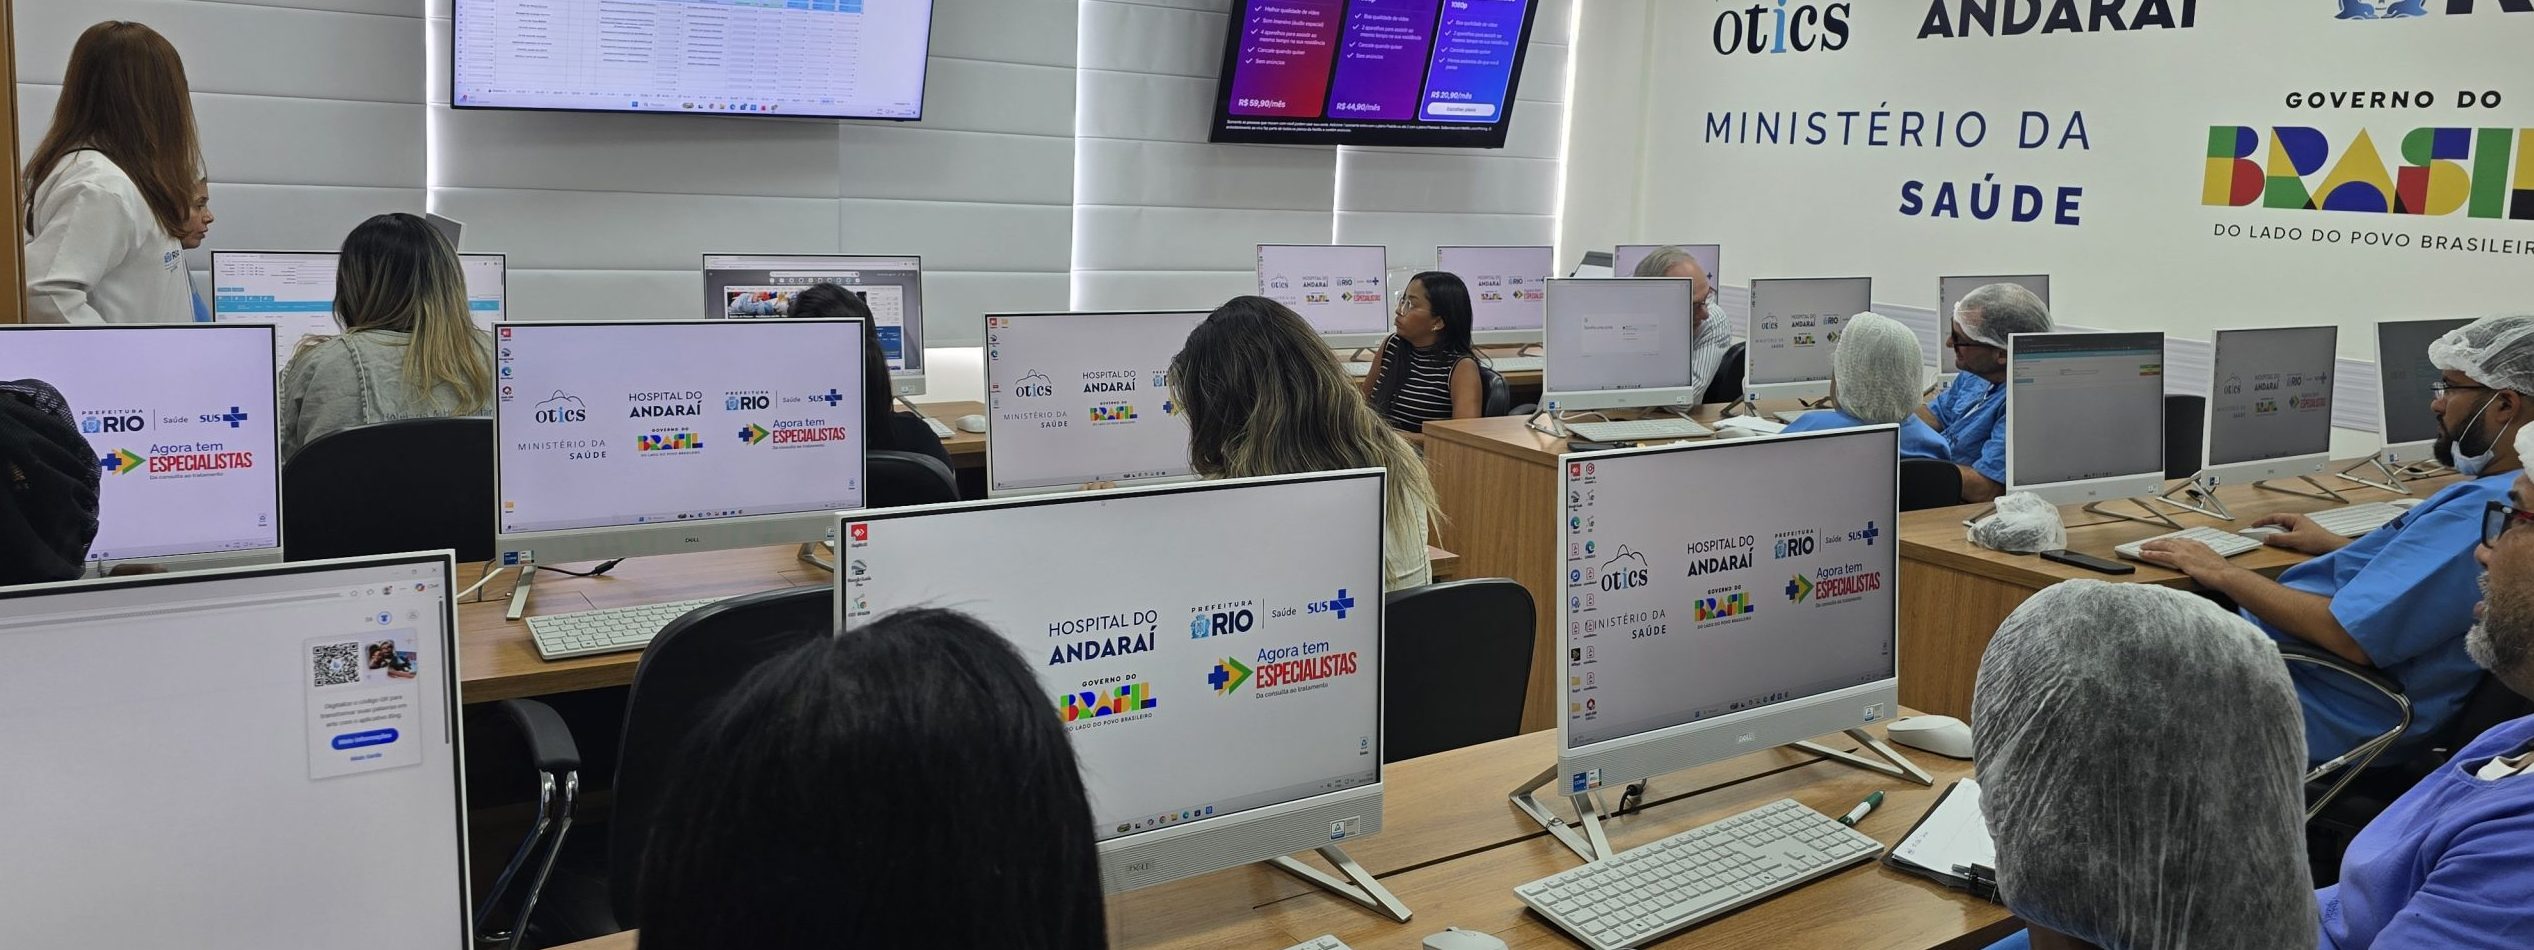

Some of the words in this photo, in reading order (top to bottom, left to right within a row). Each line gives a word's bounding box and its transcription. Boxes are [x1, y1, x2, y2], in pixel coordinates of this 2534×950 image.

[1713, 0, 1850, 55] otics
[1431, 91, 1440, 99] R$
[2285, 91, 2435, 109] GOVERNO
[2456, 90, 2502, 109] DO
[1238, 98, 1249, 107] R$
[1249, 98, 1286, 109] 59,90/mês
[1336, 102, 1346, 111] R$
[1705, 101, 1987, 148] MINISTÉRIO
[2018, 110, 2090, 150] DA
[1899, 172, 2083, 226] SAÚDE
[2214, 223, 2241, 237] DO
[2249, 225, 2302, 241] LADO
[2312, 229, 2341, 243] DO
[2350, 231, 2410, 247] POVO
[1082, 370, 1122, 380] HOSPITAL
[1123, 369, 1136, 378] DO
[1015, 383, 1052, 398] otics
[1083, 378, 1136, 394] ANDARAÍ
[628, 392, 682, 402] HOSPITAL
[686, 390, 703, 400] DO
[740, 396, 770, 410] RIO
[808, 395, 824, 403] SUS
[535, 406, 586, 424] otics
[629, 400, 702, 418] ANDARAÍ
[1003, 409, 1053, 421] MINISTÉRIO
[1055, 410, 1068, 418] DA
[1089, 405, 1138, 422] BRASIL
[103, 415, 145, 433] RIO
[163, 416, 189, 424] Saúde
[199, 414, 221, 423] SUS
[773, 419, 803, 429] Agora
[806, 418, 825, 427] tem
[1040, 419, 1068, 429] SAÚDE
[637, 432, 703, 451] BRASIL
[772, 427, 846, 443] ESPECIALISTAS
[150, 443, 192, 456] Agora
[196, 442, 223, 452] tem
[518, 439, 586, 451] MINISTÉRIO
[591, 439, 606, 447] DA
[149, 452, 253, 473] ESPECIALISTAS
[569, 450, 607, 460] SAÚDE
[1774, 529, 1814, 538] PREFEITURA
[1825, 535, 1842, 544] Saúde
[1848, 530, 1862, 541] SUS
[1687, 537, 1736, 555] HOSPITAL
[1739, 535, 1755, 547] DO
[1787, 536, 1814, 557] RIO
[1687, 547, 1754, 577] ANDARAÍ
[1816, 566, 1843, 580] Agora
[1845, 562, 1862, 573] tem
[1601, 567, 1648, 592] otics
[1815, 571, 1880, 600] ESPECIALISTAS
[1707, 585, 1732, 595] GOVERNO
[1191, 600, 1253, 613] PREFEITURA
[1271, 607, 1297, 618] Saúde
[1307, 601, 1328, 614] SUS
[1652, 608, 1666, 619] DA
[1694, 591, 1754, 624] BRASIL
[1049, 613, 1129, 638] HOSPITAL
[1133, 609, 1158, 626] DO
[1211, 609, 1254, 637] RIO
[1632, 624, 1667, 640] SAÚDE
[1049, 624, 1158, 666] ANDARAÍ
[1257, 646, 1299, 664] Agora
[1303, 641, 1329, 655] tem
[1256, 651, 1358, 689] ESPECIALISTAS
[1082, 675, 1121, 687] GOVERNO
[1125, 673, 1137, 681] DO
[1265, 688, 1290, 698] consulta
[1298, 683, 1329, 693] tratamento
[1058, 682, 1157, 723] BRASIL
[1075, 723, 1091, 731] LADO
[1103, 718, 1119, 726] POVO
[1120, 712, 1153, 723] BRASILEIRO
